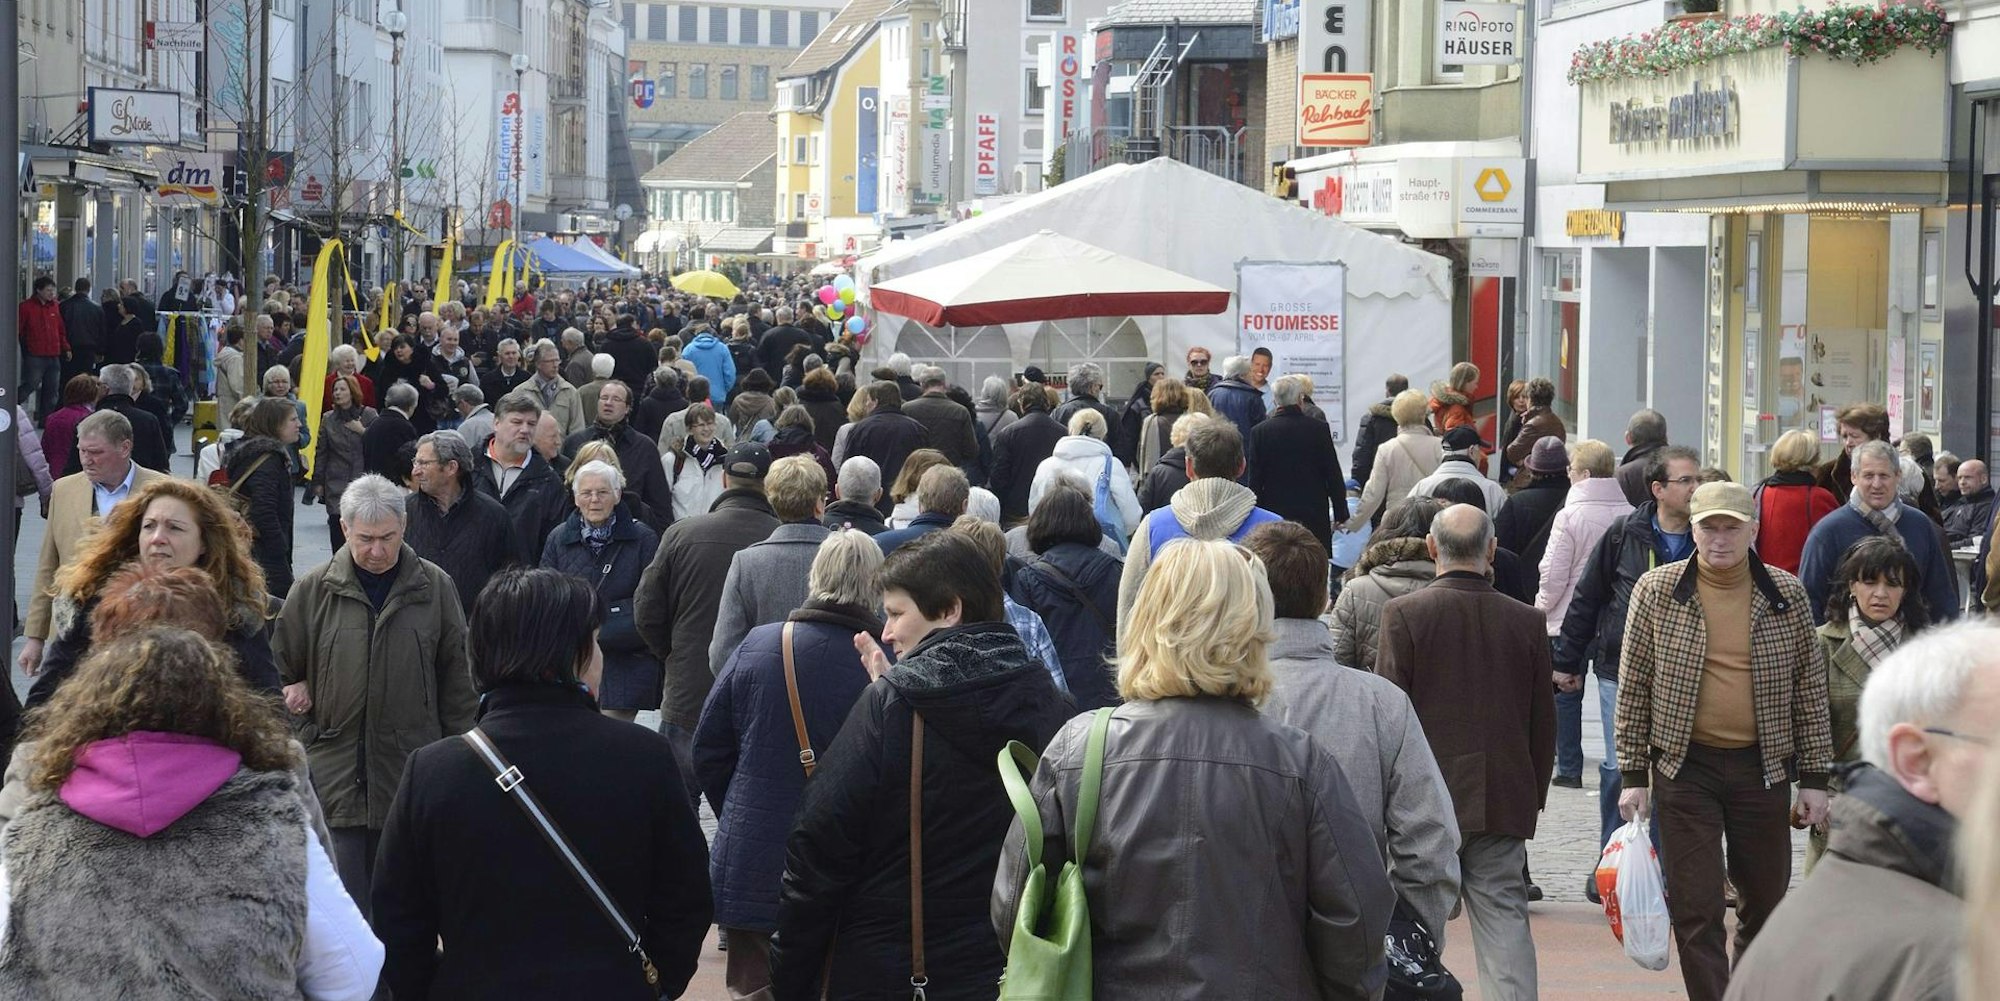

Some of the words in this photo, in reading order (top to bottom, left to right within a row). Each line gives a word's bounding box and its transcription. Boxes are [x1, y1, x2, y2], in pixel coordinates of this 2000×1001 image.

[156, 39, 202, 49] Nachhilfe
[1444, 37, 1513, 56] HÄUSER
[1315, 89, 1357, 100] BÄCKER
[1302, 99, 1372, 126] Rehbach
[131, 115, 153, 132] Mode
[498, 116, 512, 181] Elefanten
[978, 114, 996, 176] PFAFF
[930, 133, 942, 189] unitymedia
[167, 161, 211, 185] dm
[1408, 178, 1441, 192] Haupt-
[1399, 192, 1430, 201] straße
[1433, 191, 1450, 201] 179
[1270, 303, 1312, 312] GROSSE
[1243, 315, 1339, 330] FOTOMESSE
